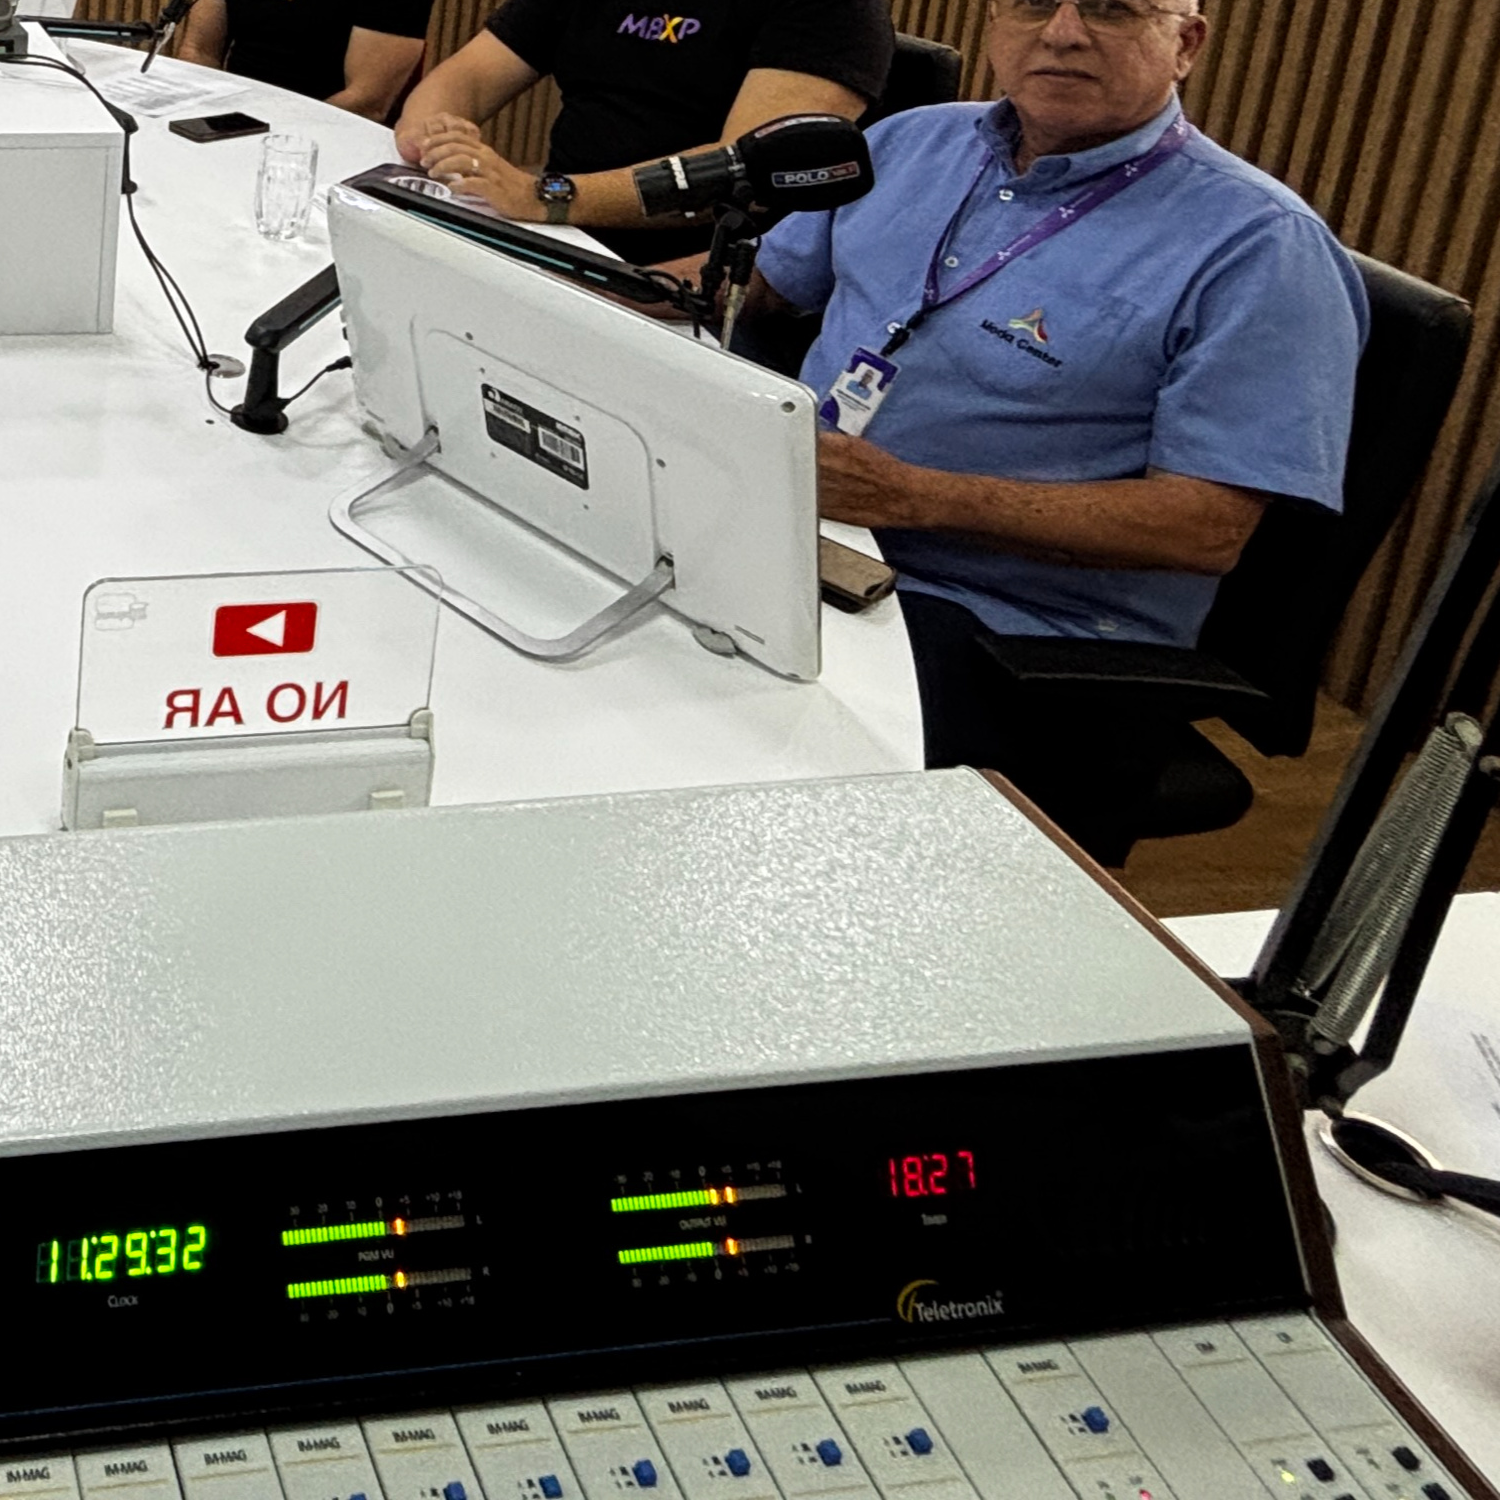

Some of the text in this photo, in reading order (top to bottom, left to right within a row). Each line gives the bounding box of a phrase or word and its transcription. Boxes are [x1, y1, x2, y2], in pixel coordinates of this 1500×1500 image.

[616, 13, 701, 43] MBXP
[784, 171, 829, 184] POLO
[914, 1294, 1004, 1322] Teletronix
